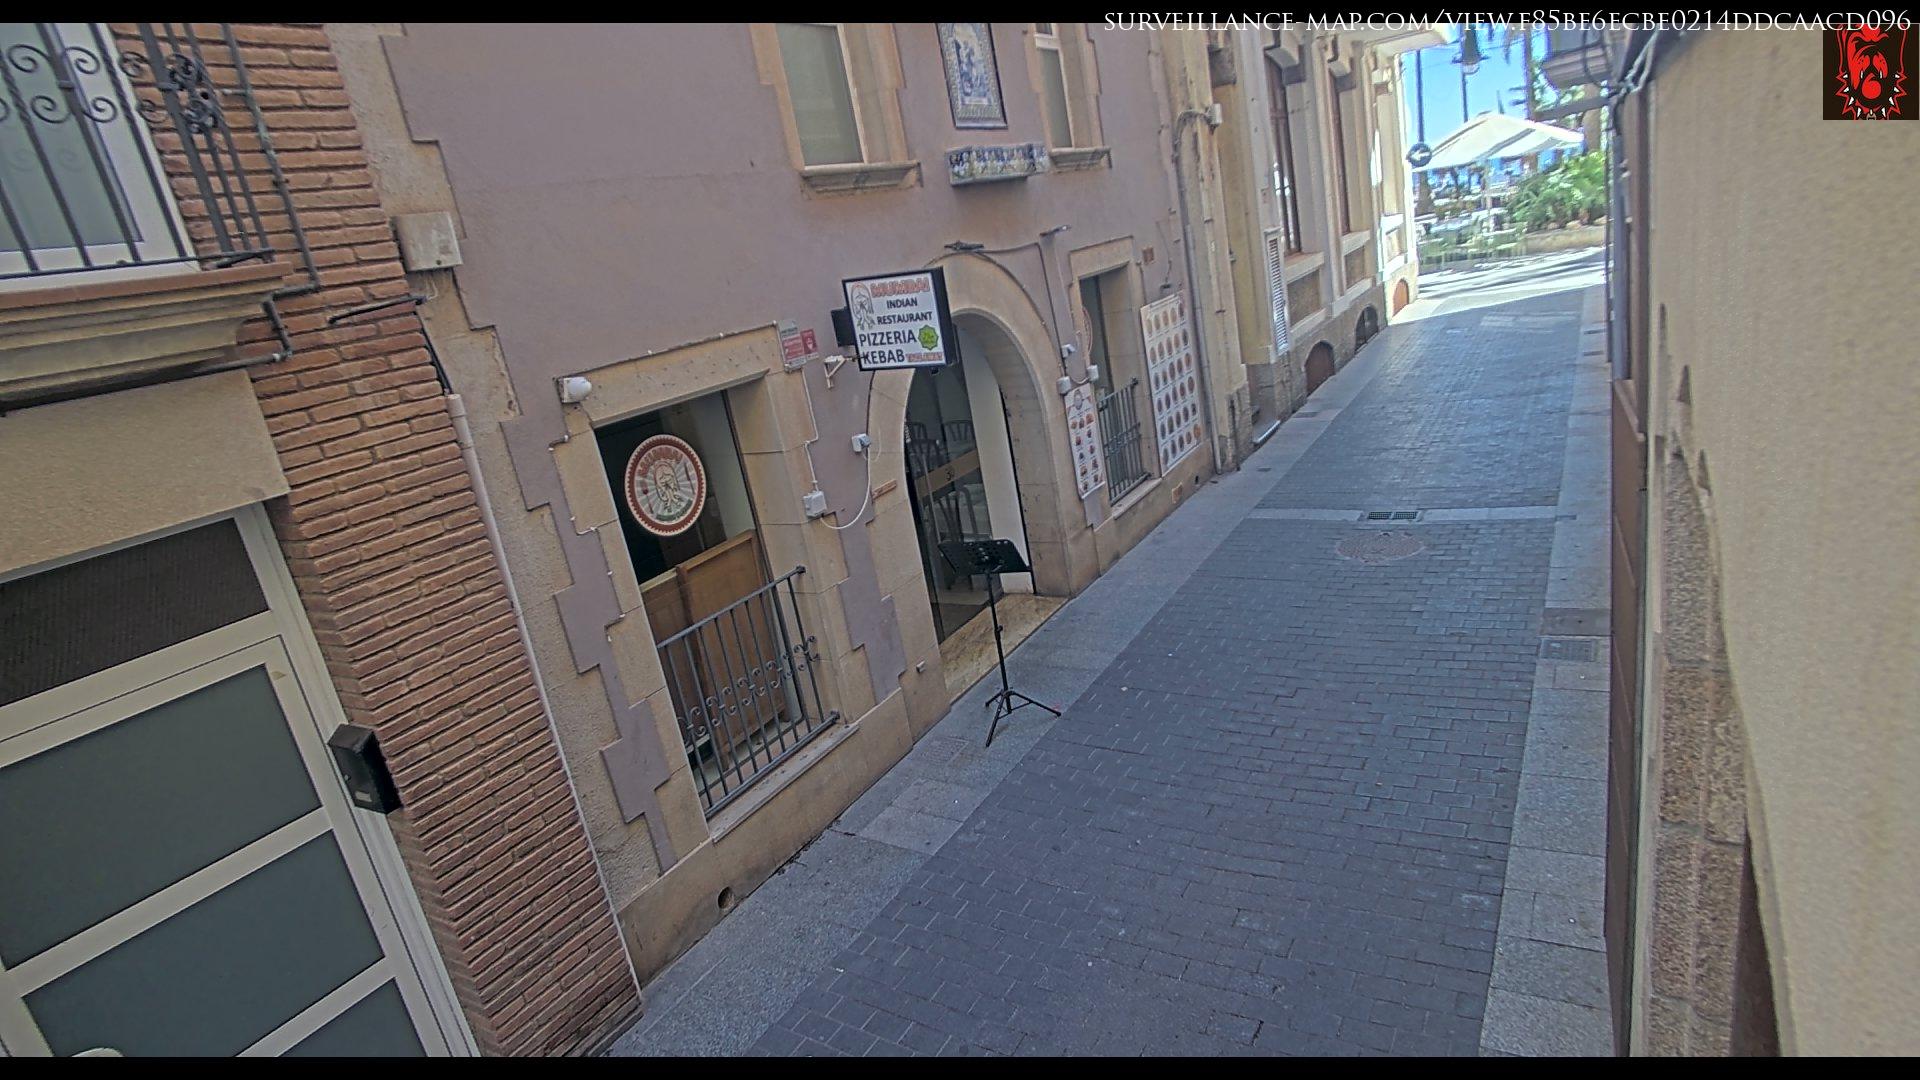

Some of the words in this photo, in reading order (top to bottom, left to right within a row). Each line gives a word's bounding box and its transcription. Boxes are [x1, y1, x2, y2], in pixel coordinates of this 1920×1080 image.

[887, 298, 918, 309] INDIAN
[877, 312, 932, 325] RESTAURANT
[859, 330, 917, 346] PIZZERIA
[862, 349, 904, 364] KEBAB
